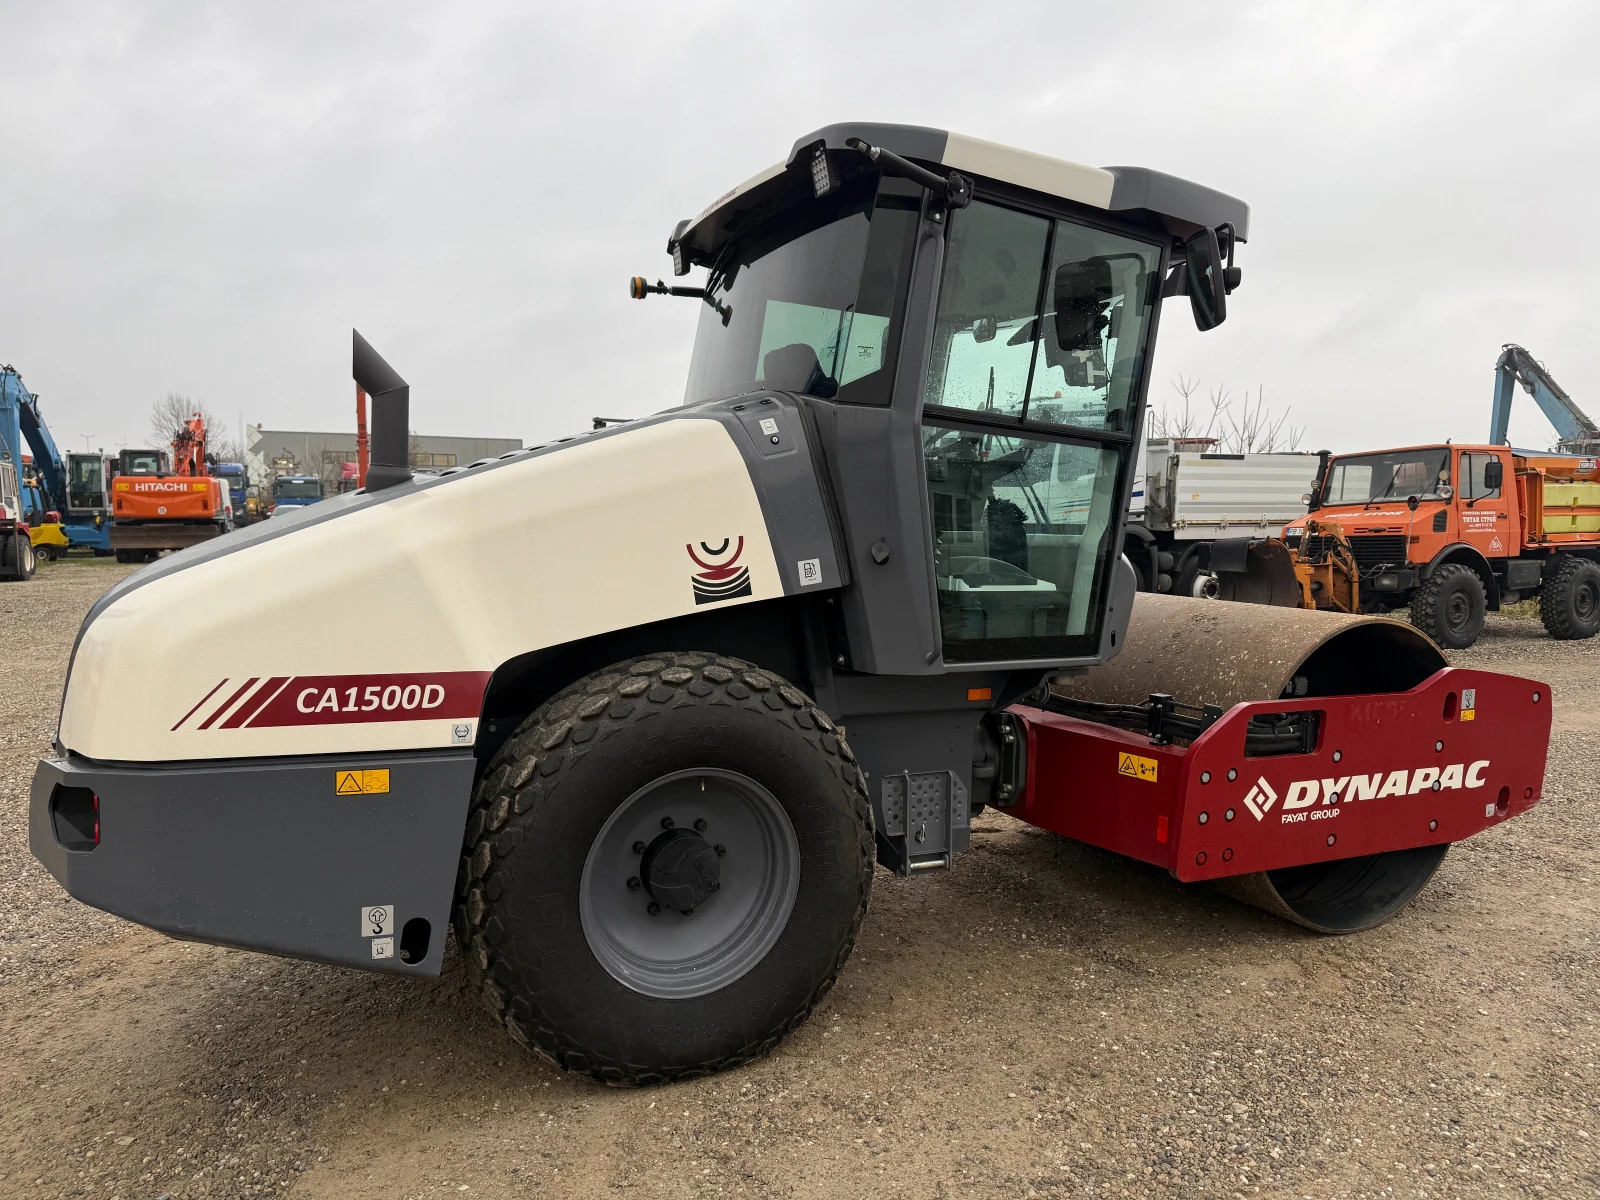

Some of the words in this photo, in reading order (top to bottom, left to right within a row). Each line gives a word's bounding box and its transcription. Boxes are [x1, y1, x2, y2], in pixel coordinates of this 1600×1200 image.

[135, 483, 187, 492] HITACHI
[296, 684, 445, 714] CA1500D
[1281, 760, 1490, 810] DYNAPAC
[1281, 812, 1308, 824] FAYAT
[1310, 808, 1340, 821] GROUP
